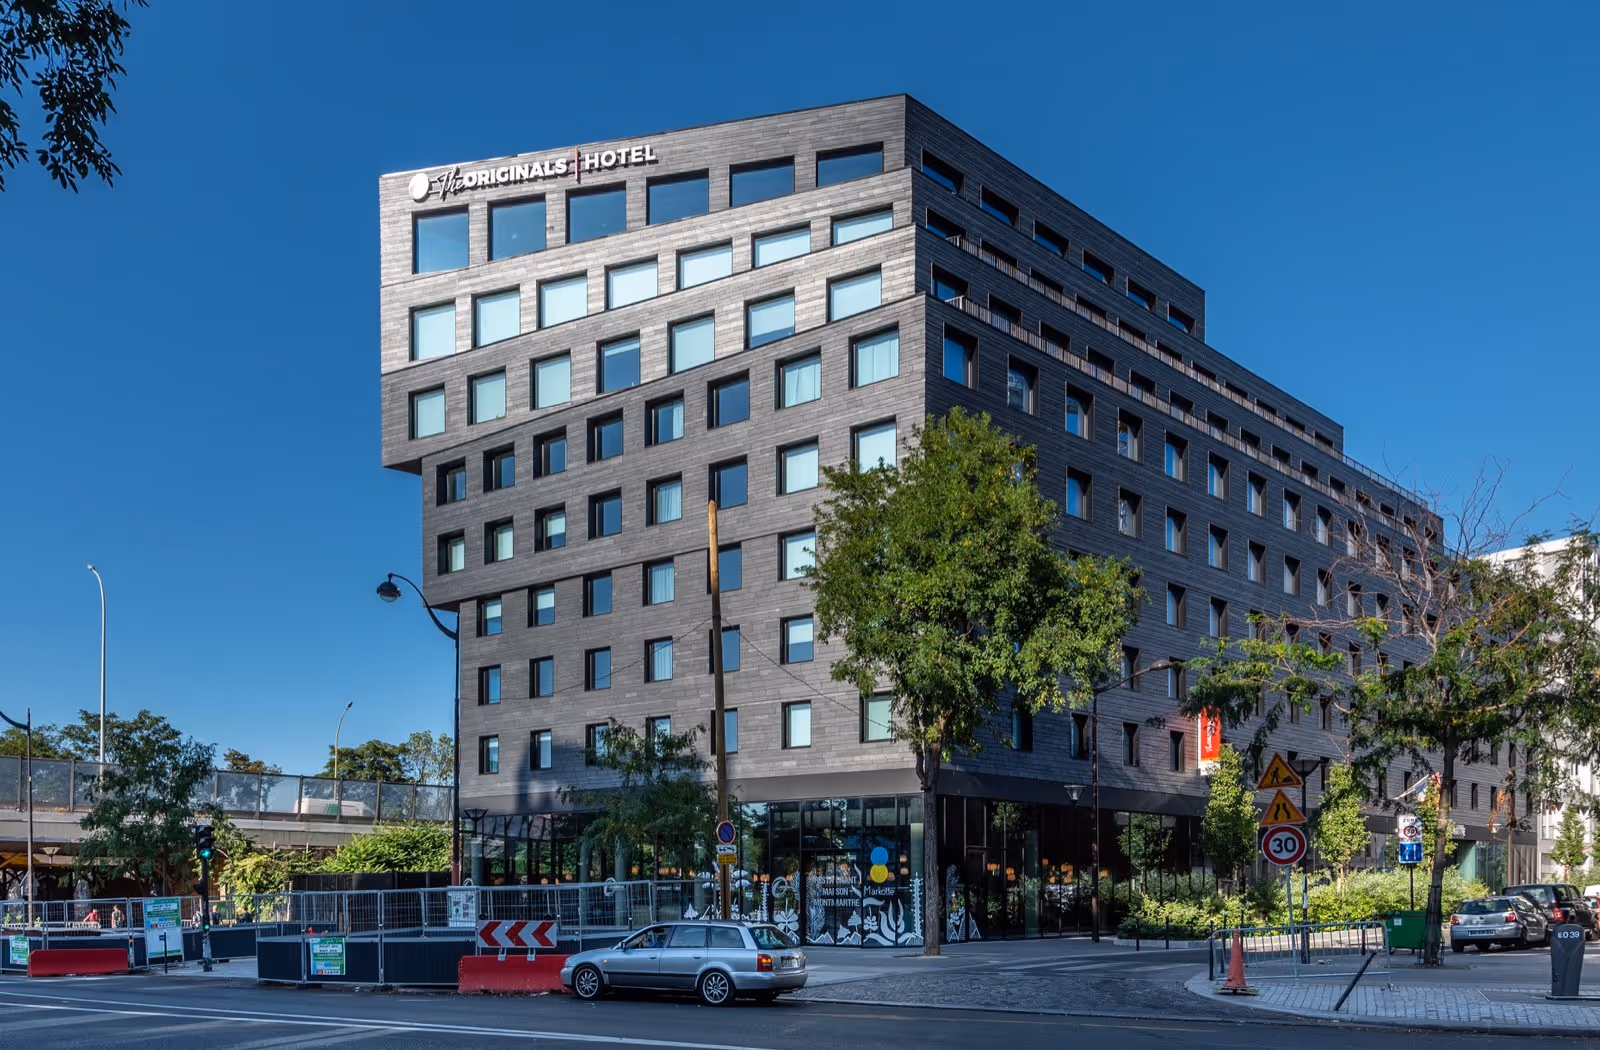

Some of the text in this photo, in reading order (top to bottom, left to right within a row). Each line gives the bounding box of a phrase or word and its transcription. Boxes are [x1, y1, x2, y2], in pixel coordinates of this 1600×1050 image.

[438, 144, 656, 199] The ORIGINALS HOTEL
[1272, 837, 1297, 854] 30
[822, 887, 849, 896] MAISON
